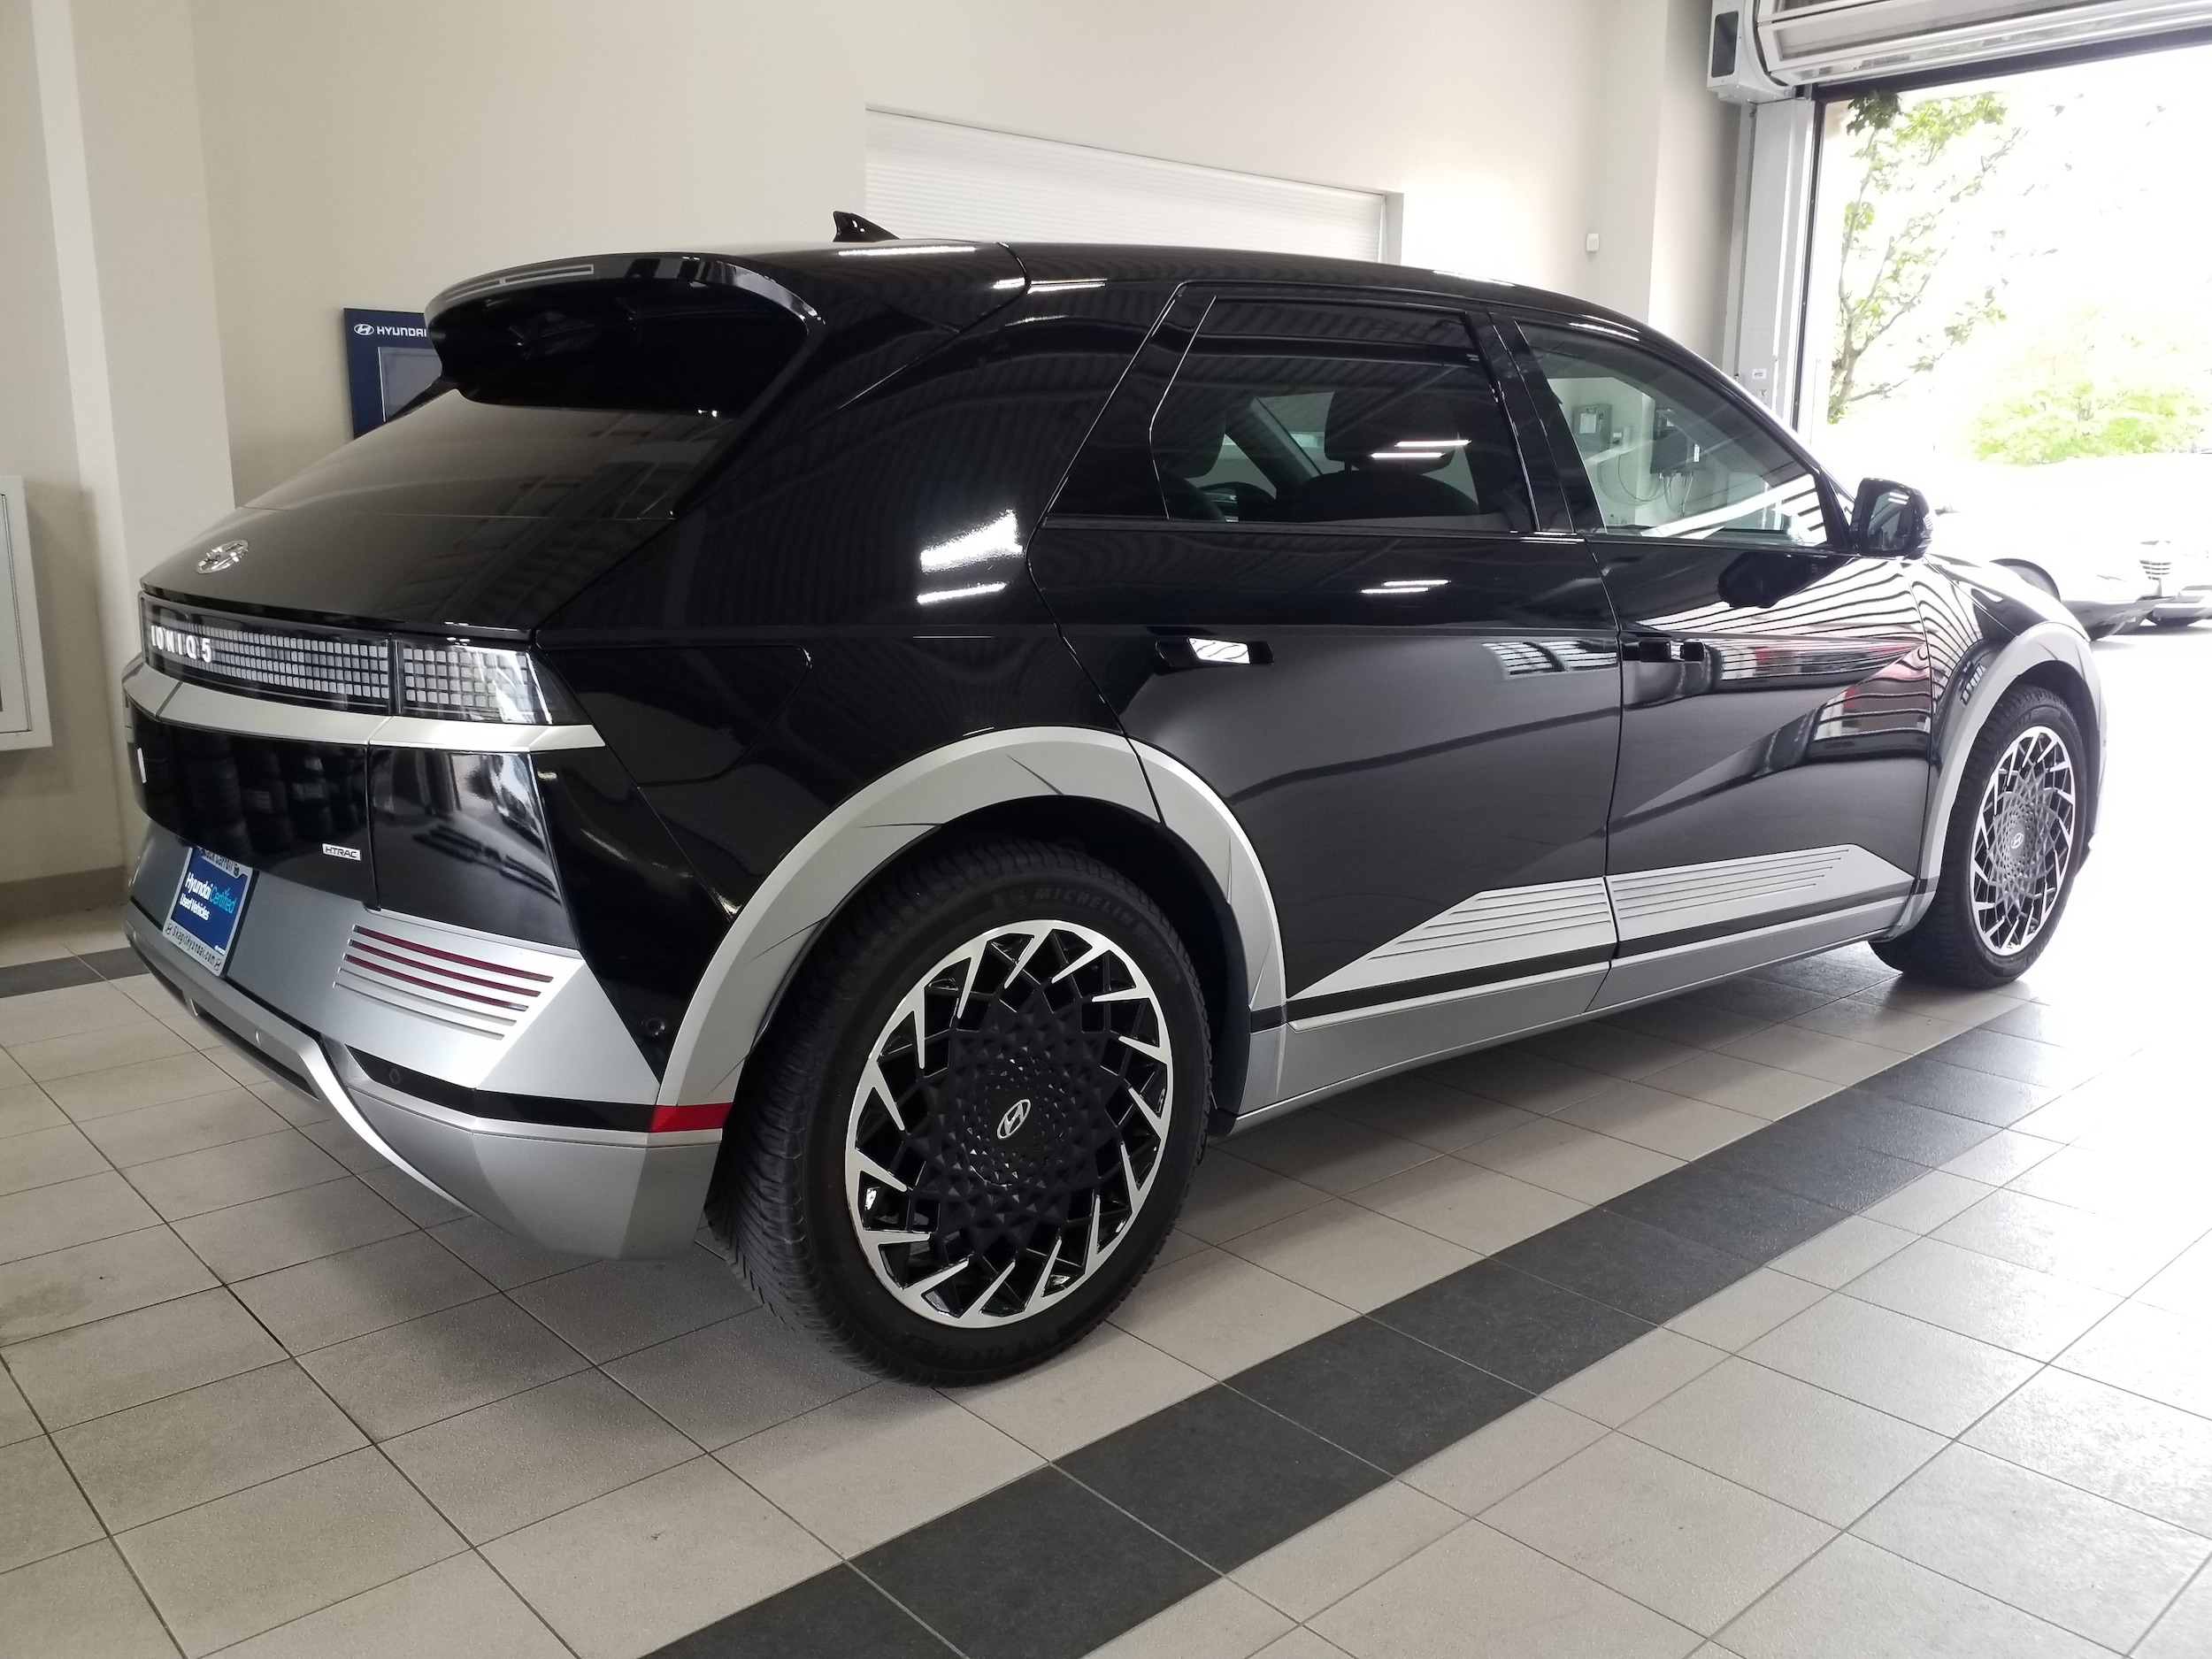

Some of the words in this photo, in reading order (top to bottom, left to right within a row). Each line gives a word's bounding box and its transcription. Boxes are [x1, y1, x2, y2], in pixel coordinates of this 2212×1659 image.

[376, 326, 427, 337] HYUNDAI
[150, 625, 197, 660] IONIQ
[202, 637, 212, 664] 5
[325, 846, 357, 858] HTRAC
[180, 893, 194, 910] Used
[190, 899, 211, 921] Vehicles
[185, 872, 213, 901] Hyundai
[210, 886, 237, 914] Certified
[1034, 887, 1134, 926] MICHELIN
